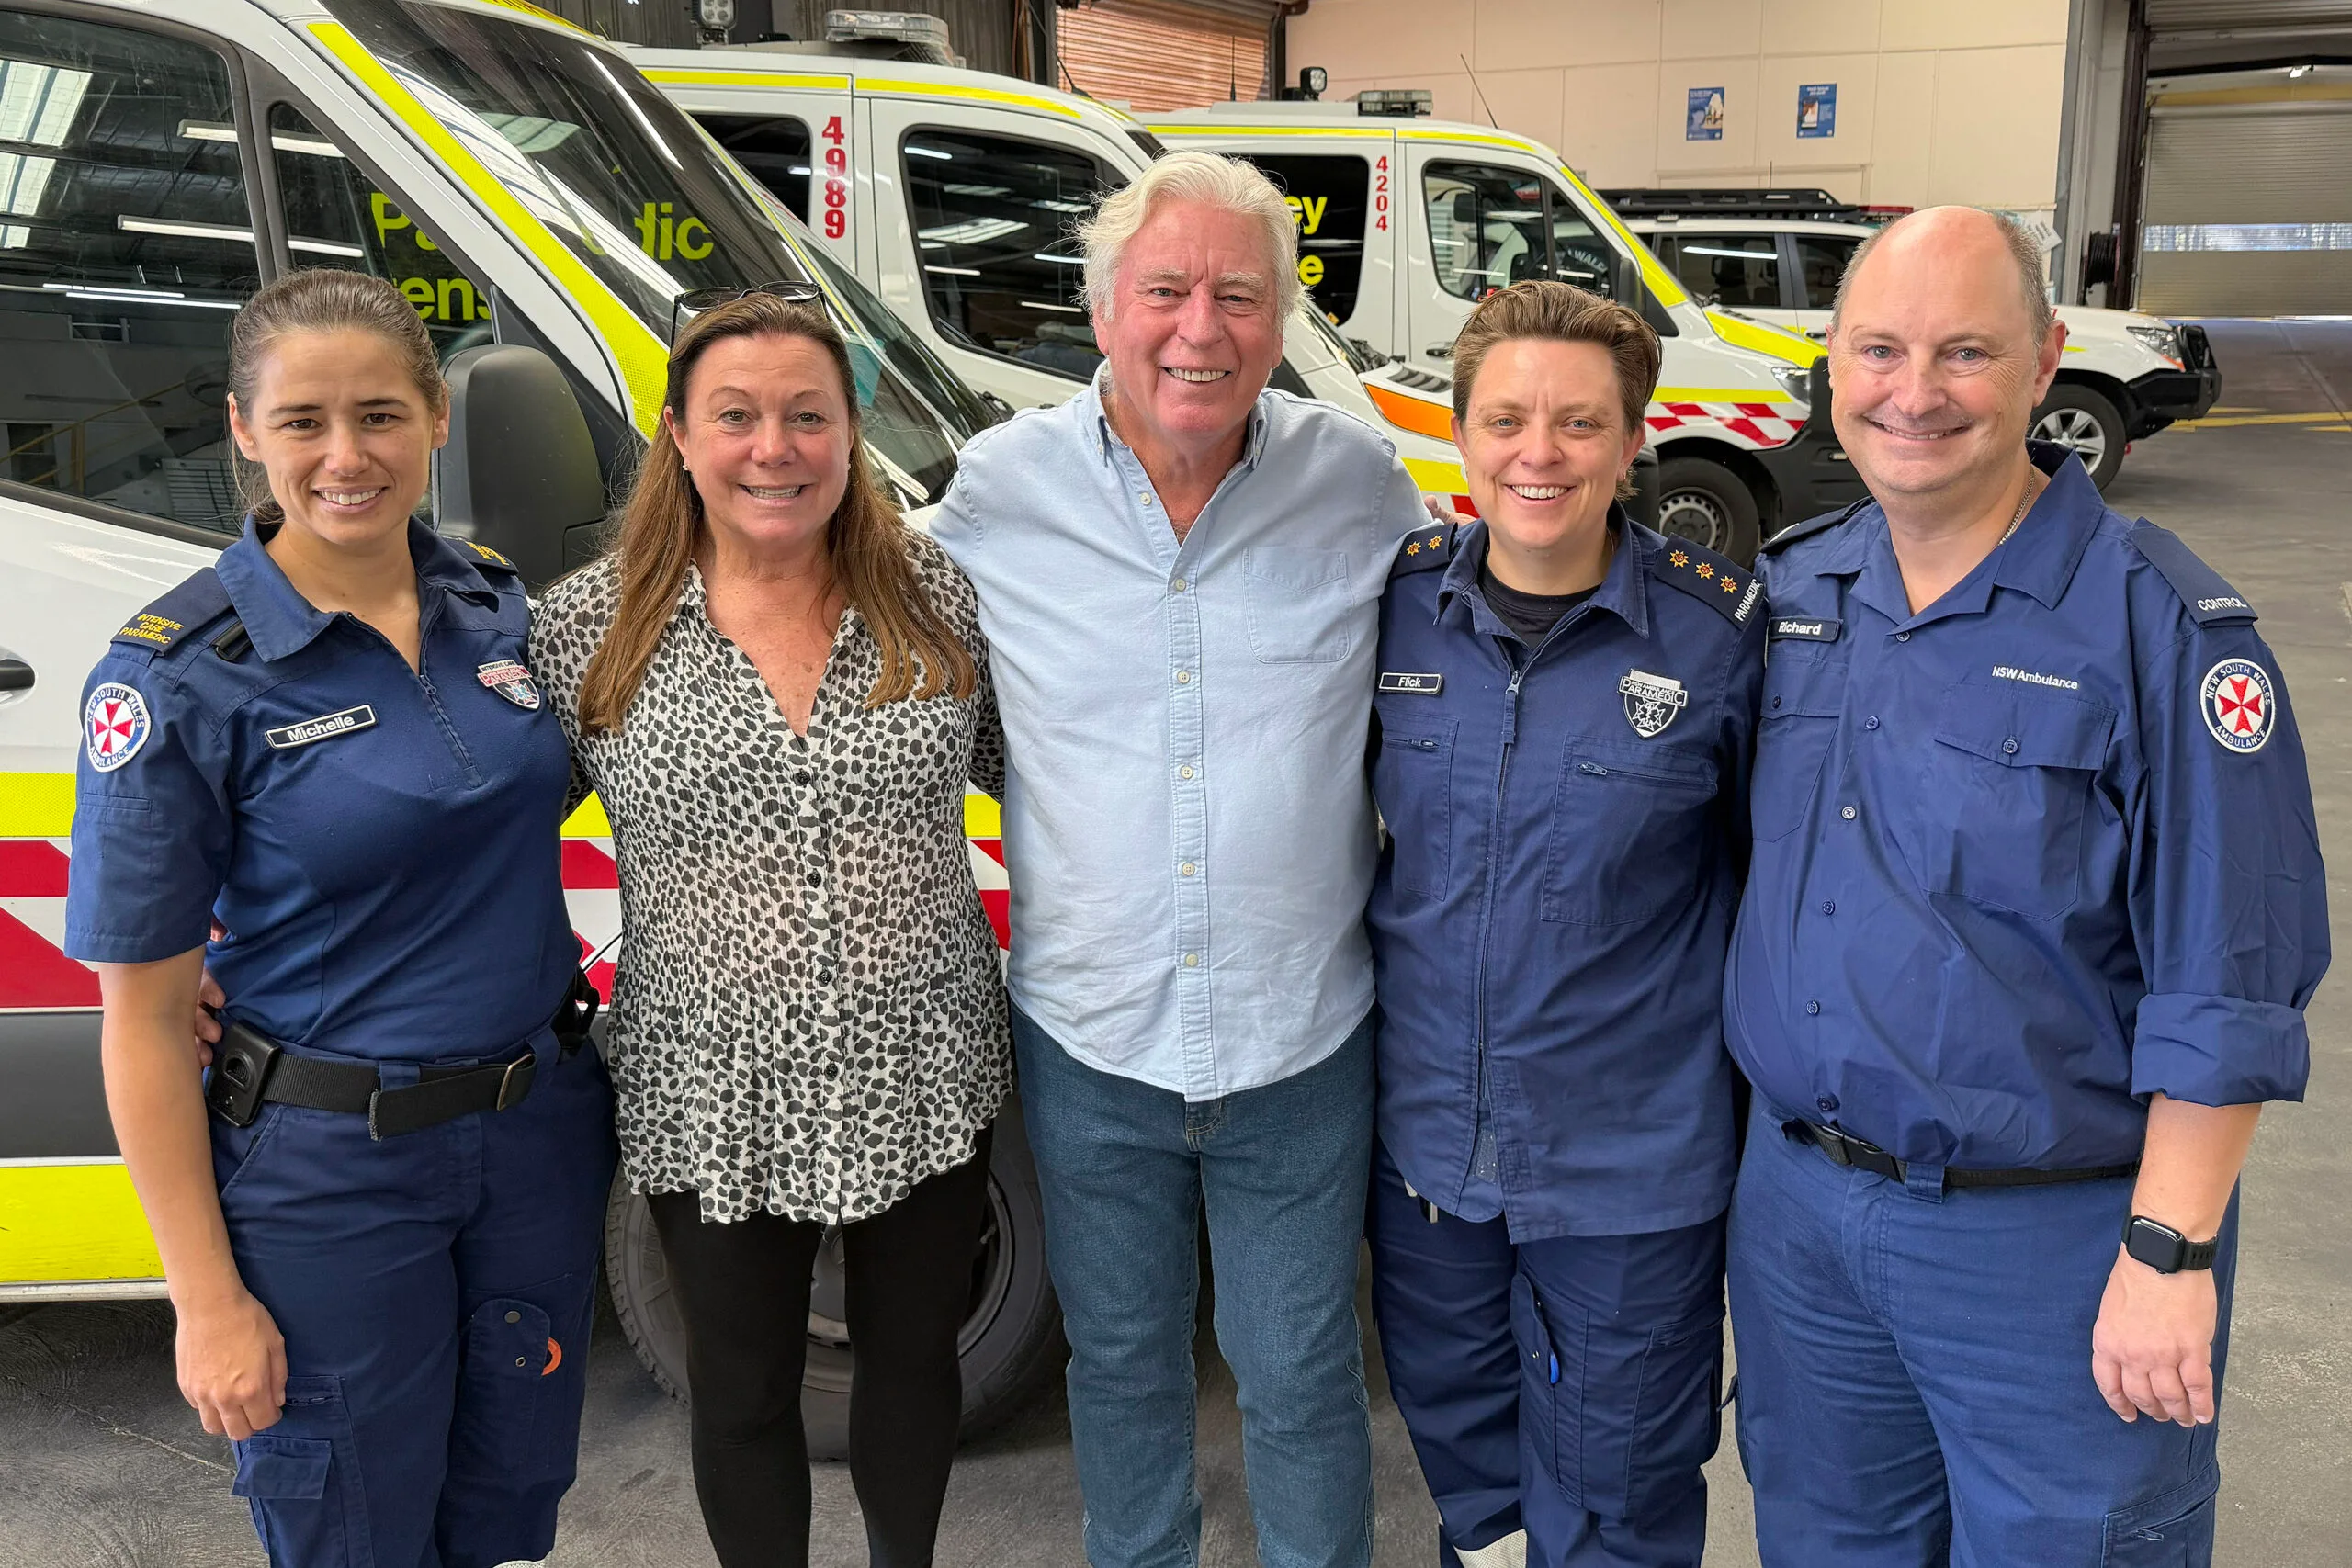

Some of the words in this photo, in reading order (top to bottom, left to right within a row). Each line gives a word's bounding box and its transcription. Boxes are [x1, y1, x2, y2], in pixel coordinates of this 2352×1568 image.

[821, 116, 846, 239] 4989
[1375, 155, 1388, 231] 4204
[1734, 579, 1764, 622] PARAMEDIC
[2198, 597, 2247, 611] CONTROL
[137, 613, 184, 631] INTENSIVE
[140, 621, 165, 633] CARE
[1778, 621, 1822, 636] Richard
[119, 626, 172, 644] PARAMEDIC
[1398, 677, 1421, 687] Flick
[1992, 666, 2018, 680] NSW
[2017, 670, 2078, 690] Ambulance
[2206, 675, 2221, 699] NEW
[2220, 663, 2250, 677] SOUTH
[2253, 670, 2271, 705] WALES
[1623, 679, 1684, 705] PARAMEDIC
[96, 688, 126, 701] SOUTH
[127, 694, 145, 728] WALES
[287, 716, 356, 741] Michelle
[2215, 726, 2266, 748] AMBULANCE
